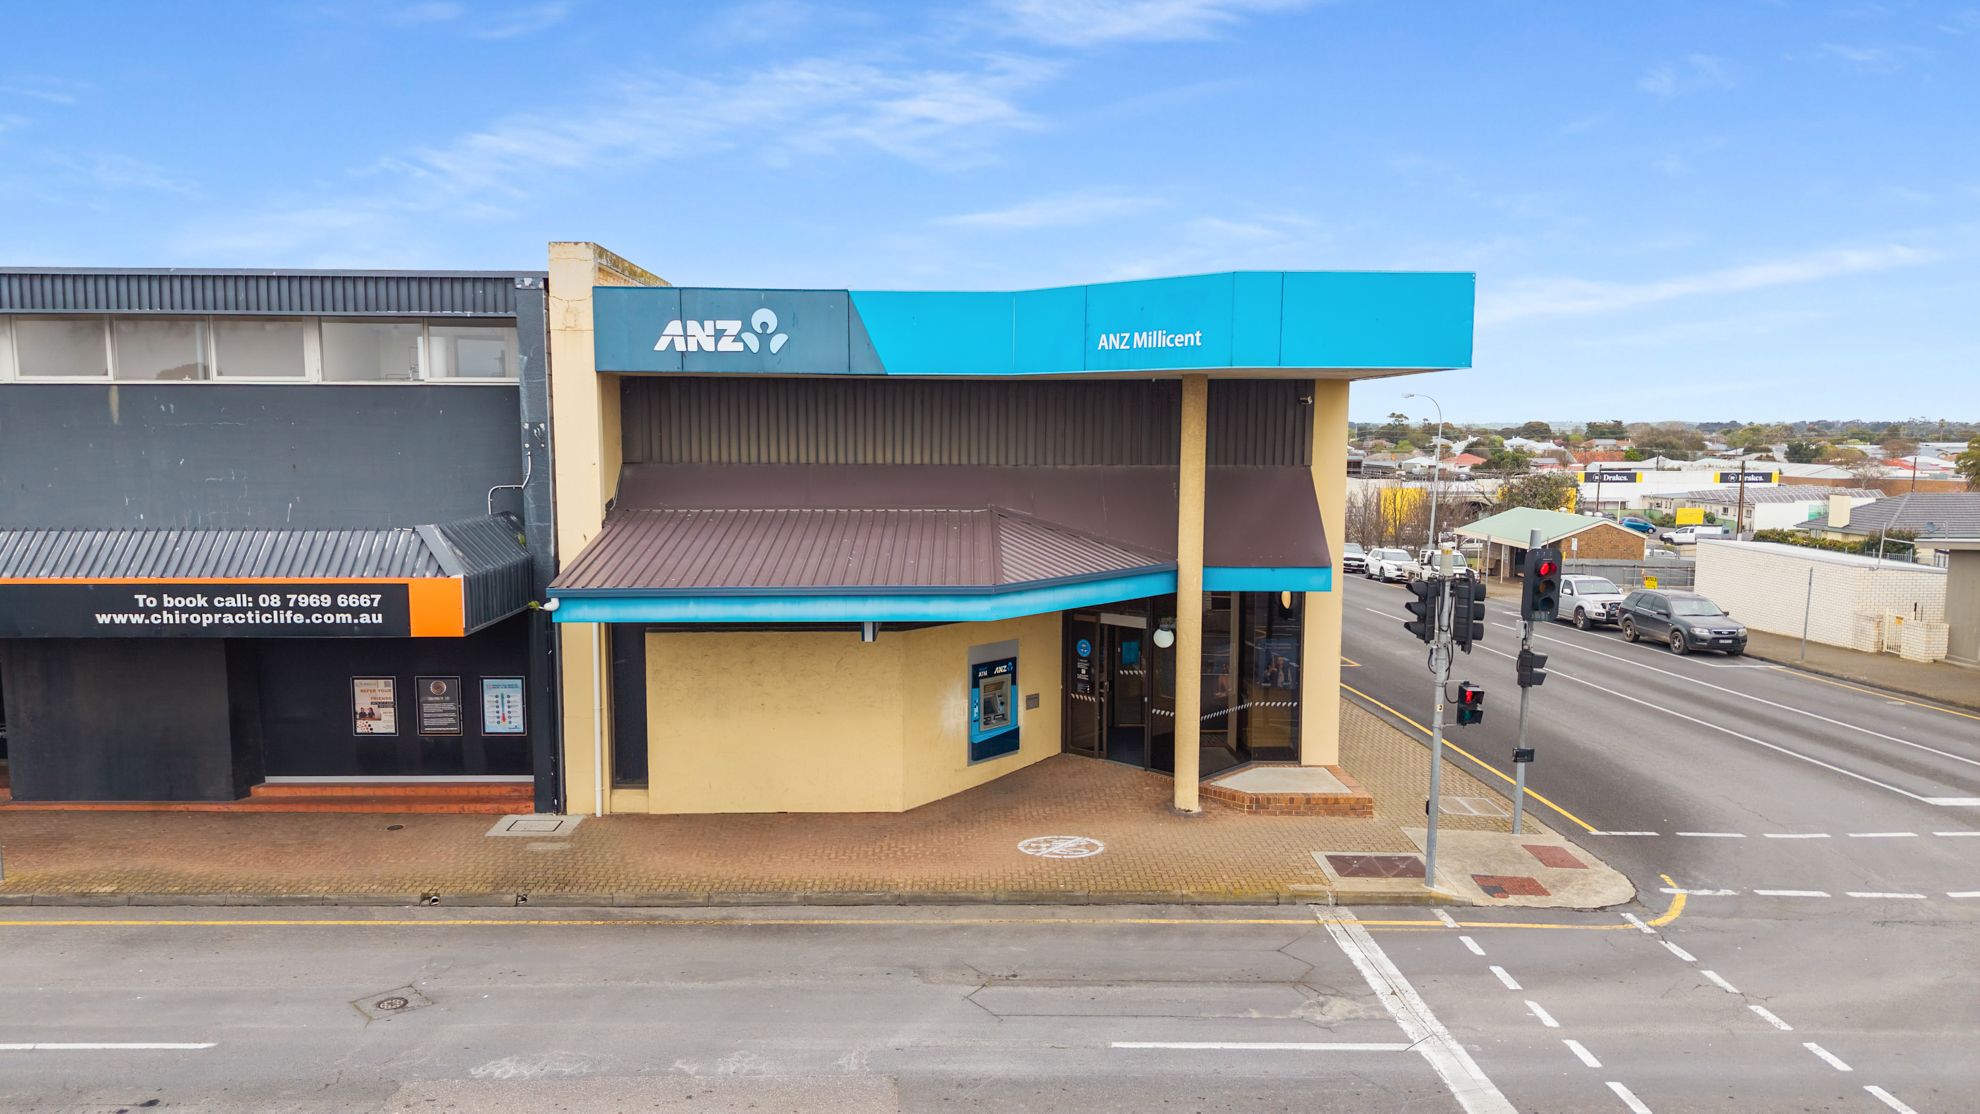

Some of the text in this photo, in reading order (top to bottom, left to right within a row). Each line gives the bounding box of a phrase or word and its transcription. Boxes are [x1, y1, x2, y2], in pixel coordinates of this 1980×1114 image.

[653, 319, 744, 352] ANZ
[1098, 330, 1202, 351] ANZ Millicent
[134, 593, 382, 608] To book call: 08 7969 6667
[95, 611, 383, 627] www.chiropracticlife.com.au
